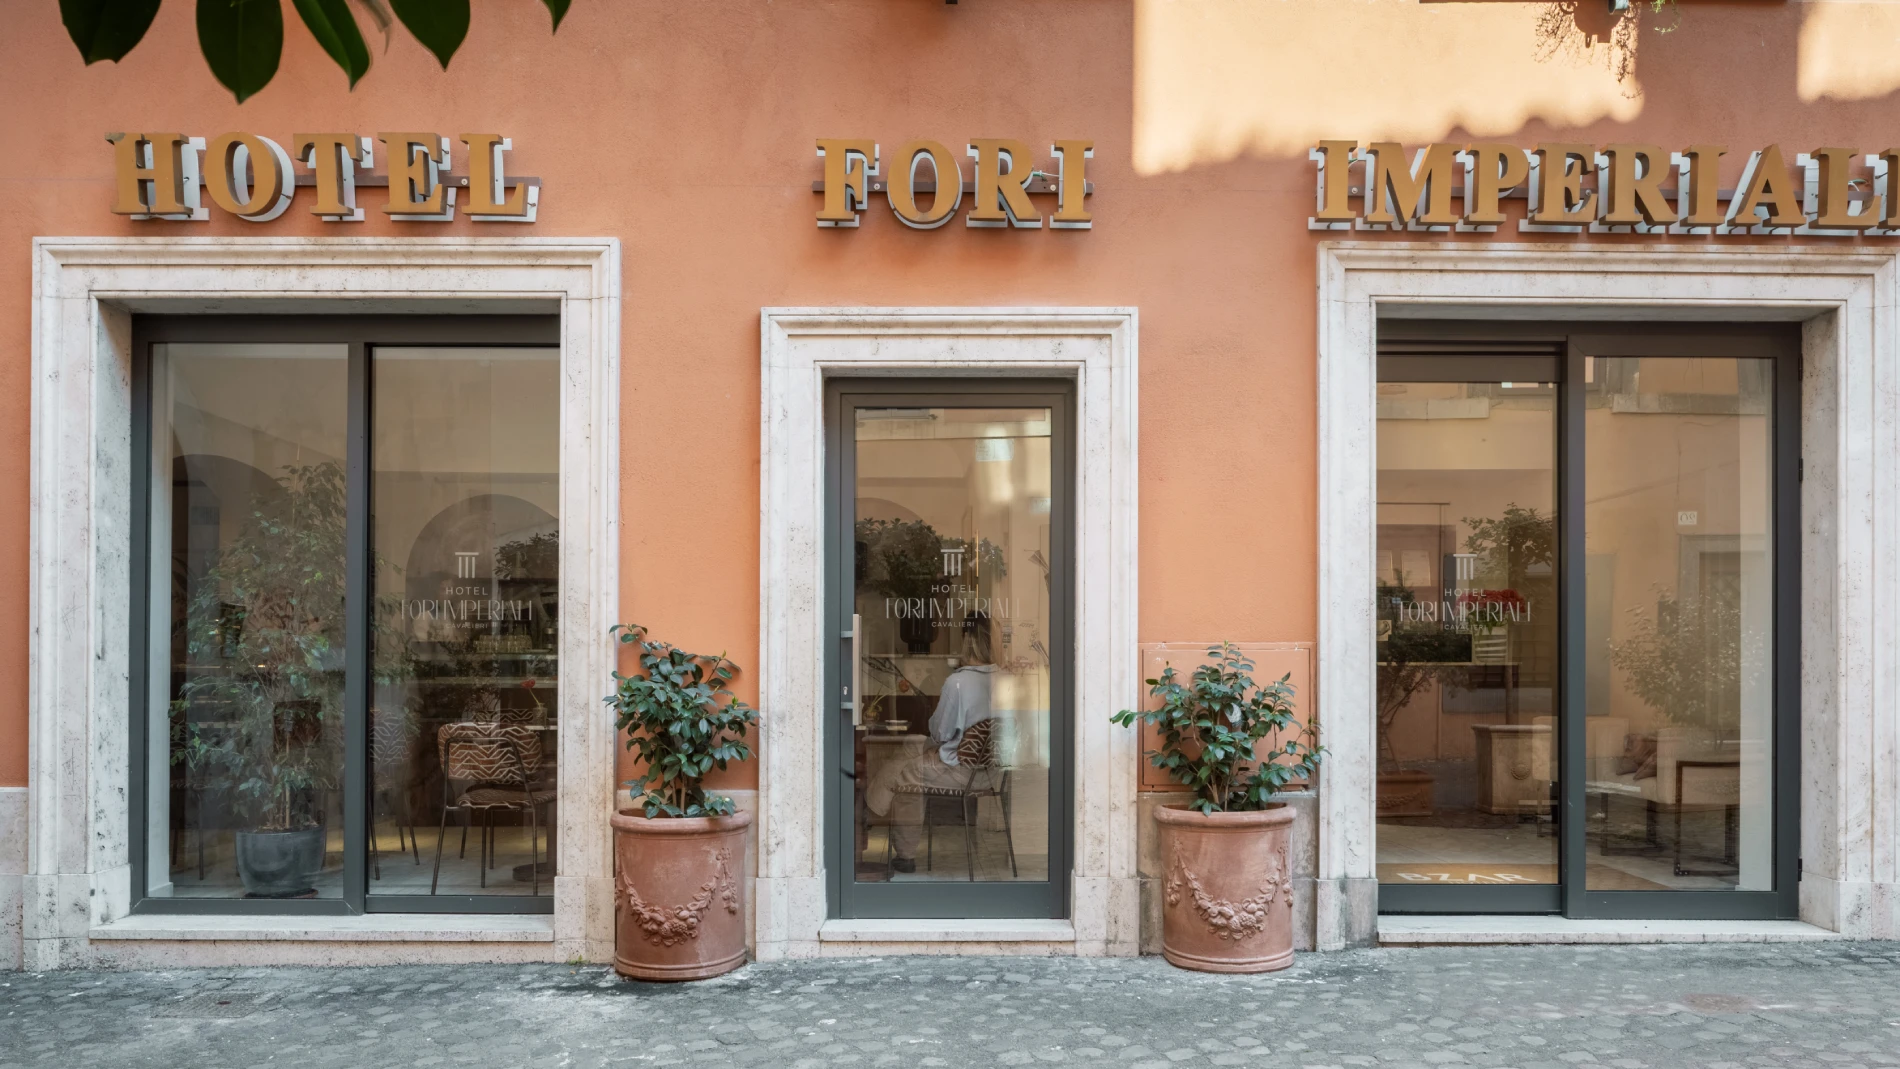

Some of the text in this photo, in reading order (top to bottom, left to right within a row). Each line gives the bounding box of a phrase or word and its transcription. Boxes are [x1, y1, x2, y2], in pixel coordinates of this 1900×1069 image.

[104, 131, 536, 220] HOTEL
[816, 138, 1094, 228] FORI
[445, 586, 489, 596] HOTEL
[931, 584, 975, 593] HOTEL
[1444, 588, 1487, 597] HOTEL
